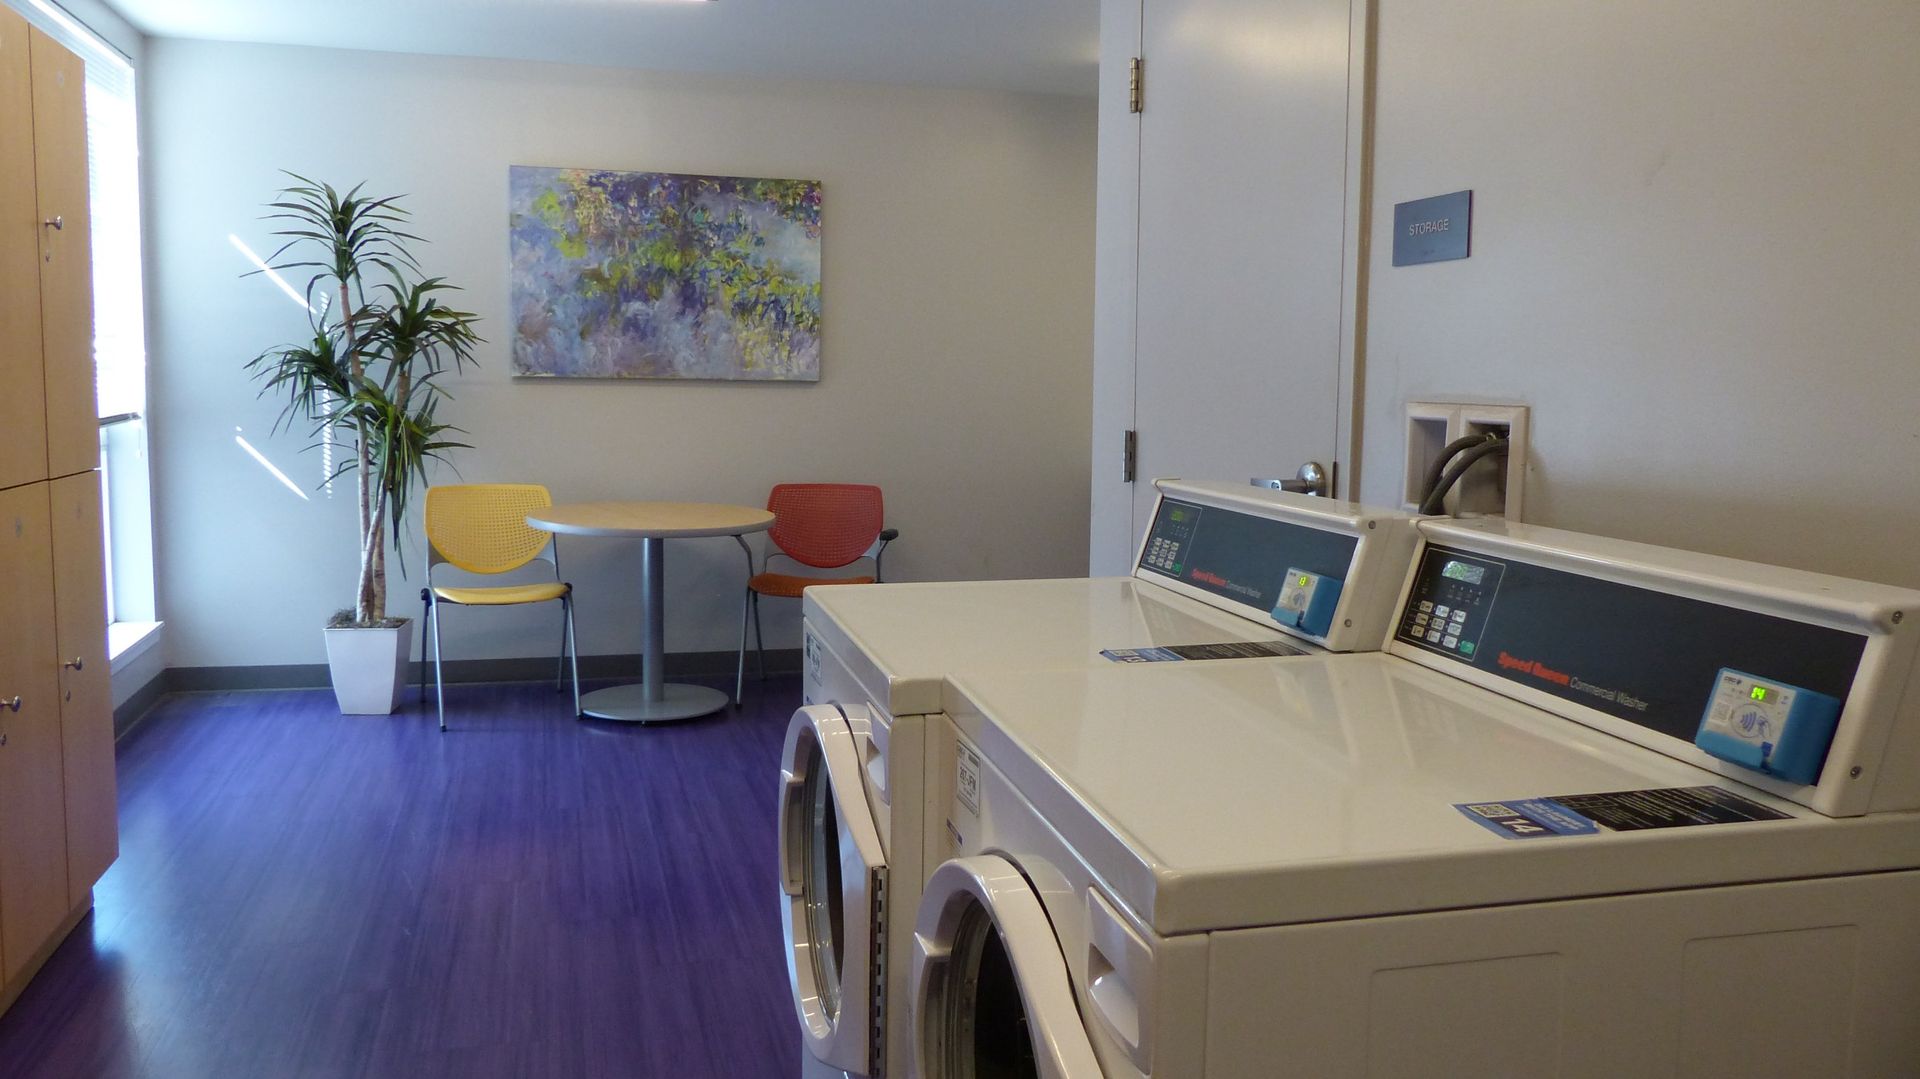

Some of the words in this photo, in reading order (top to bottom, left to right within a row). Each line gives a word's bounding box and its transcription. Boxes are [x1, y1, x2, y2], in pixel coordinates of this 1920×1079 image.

[1409, 218, 1449, 236] STORAGE
[1498, 651, 1533, 673] Speed
[1532, 662, 1570, 686] Queen
[1570, 676, 1617, 701] Commercial
[1616, 690, 1649, 711] Washer
[1501, 818, 1545, 833] 14
